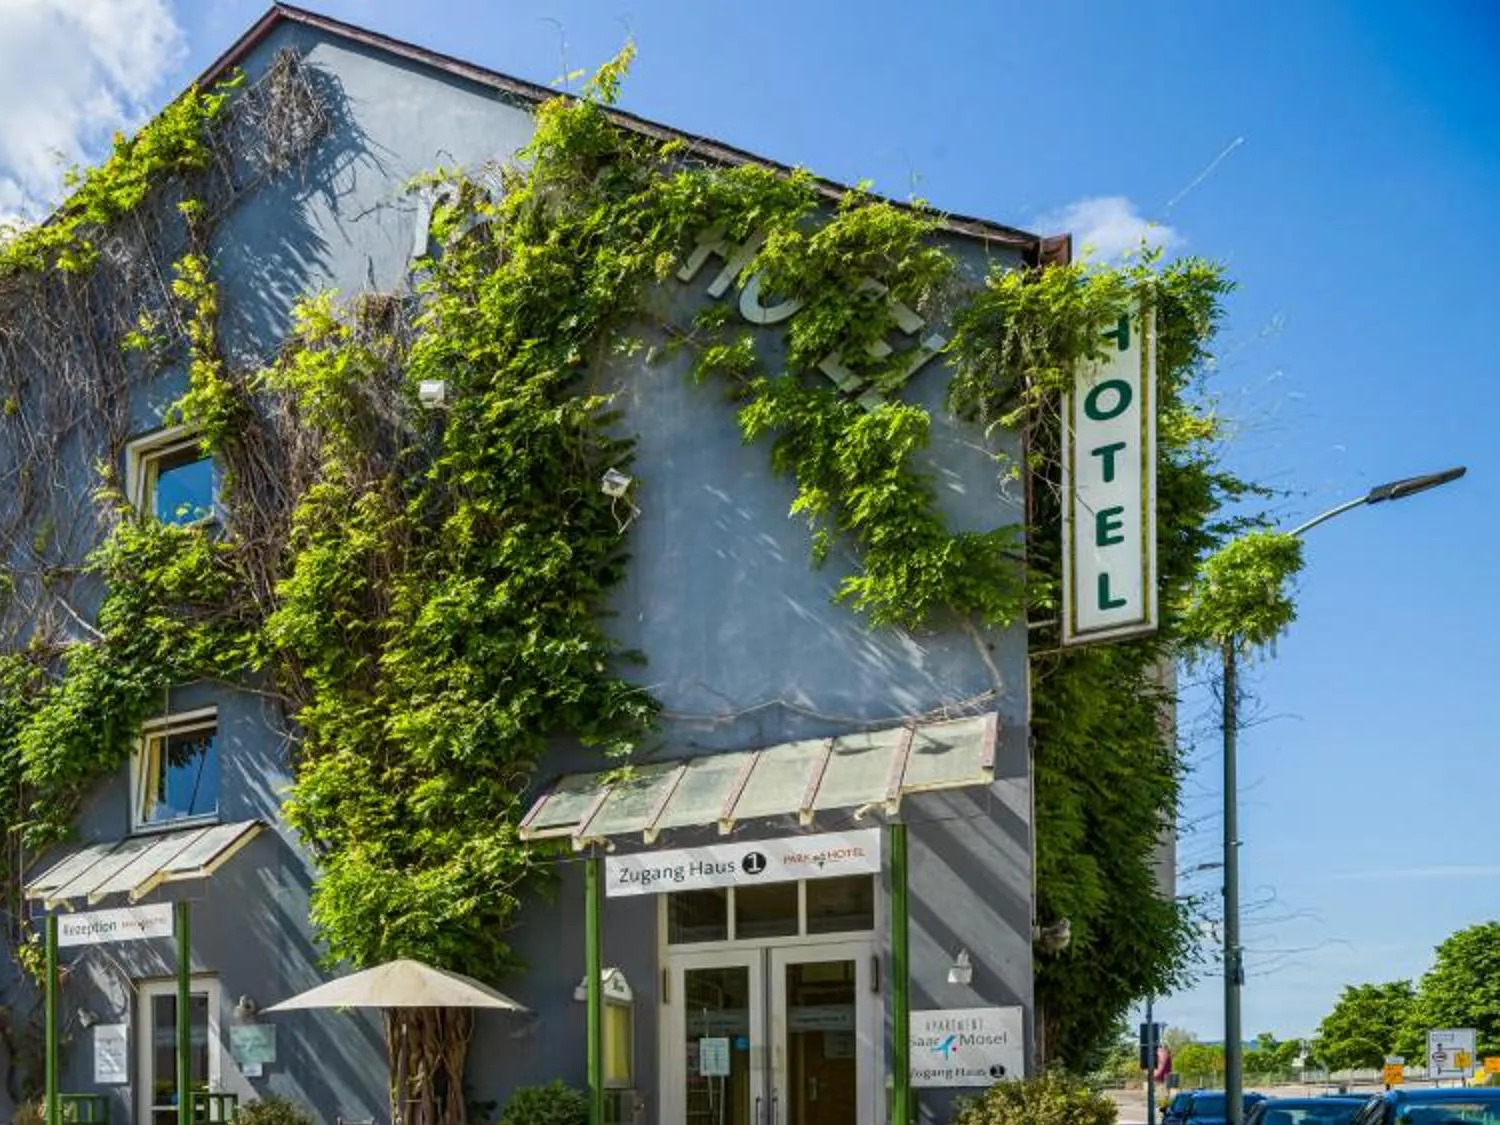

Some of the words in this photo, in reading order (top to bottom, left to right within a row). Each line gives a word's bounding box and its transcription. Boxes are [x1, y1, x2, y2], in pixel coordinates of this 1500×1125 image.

[783, 853, 810, 865] PARK
[827, 847, 866, 860] HOTEL
[619, 865, 685, 884] Zugang
[689, 861, 735, 876] Haus
[959, 1031, 1007, 1046] Mosel
